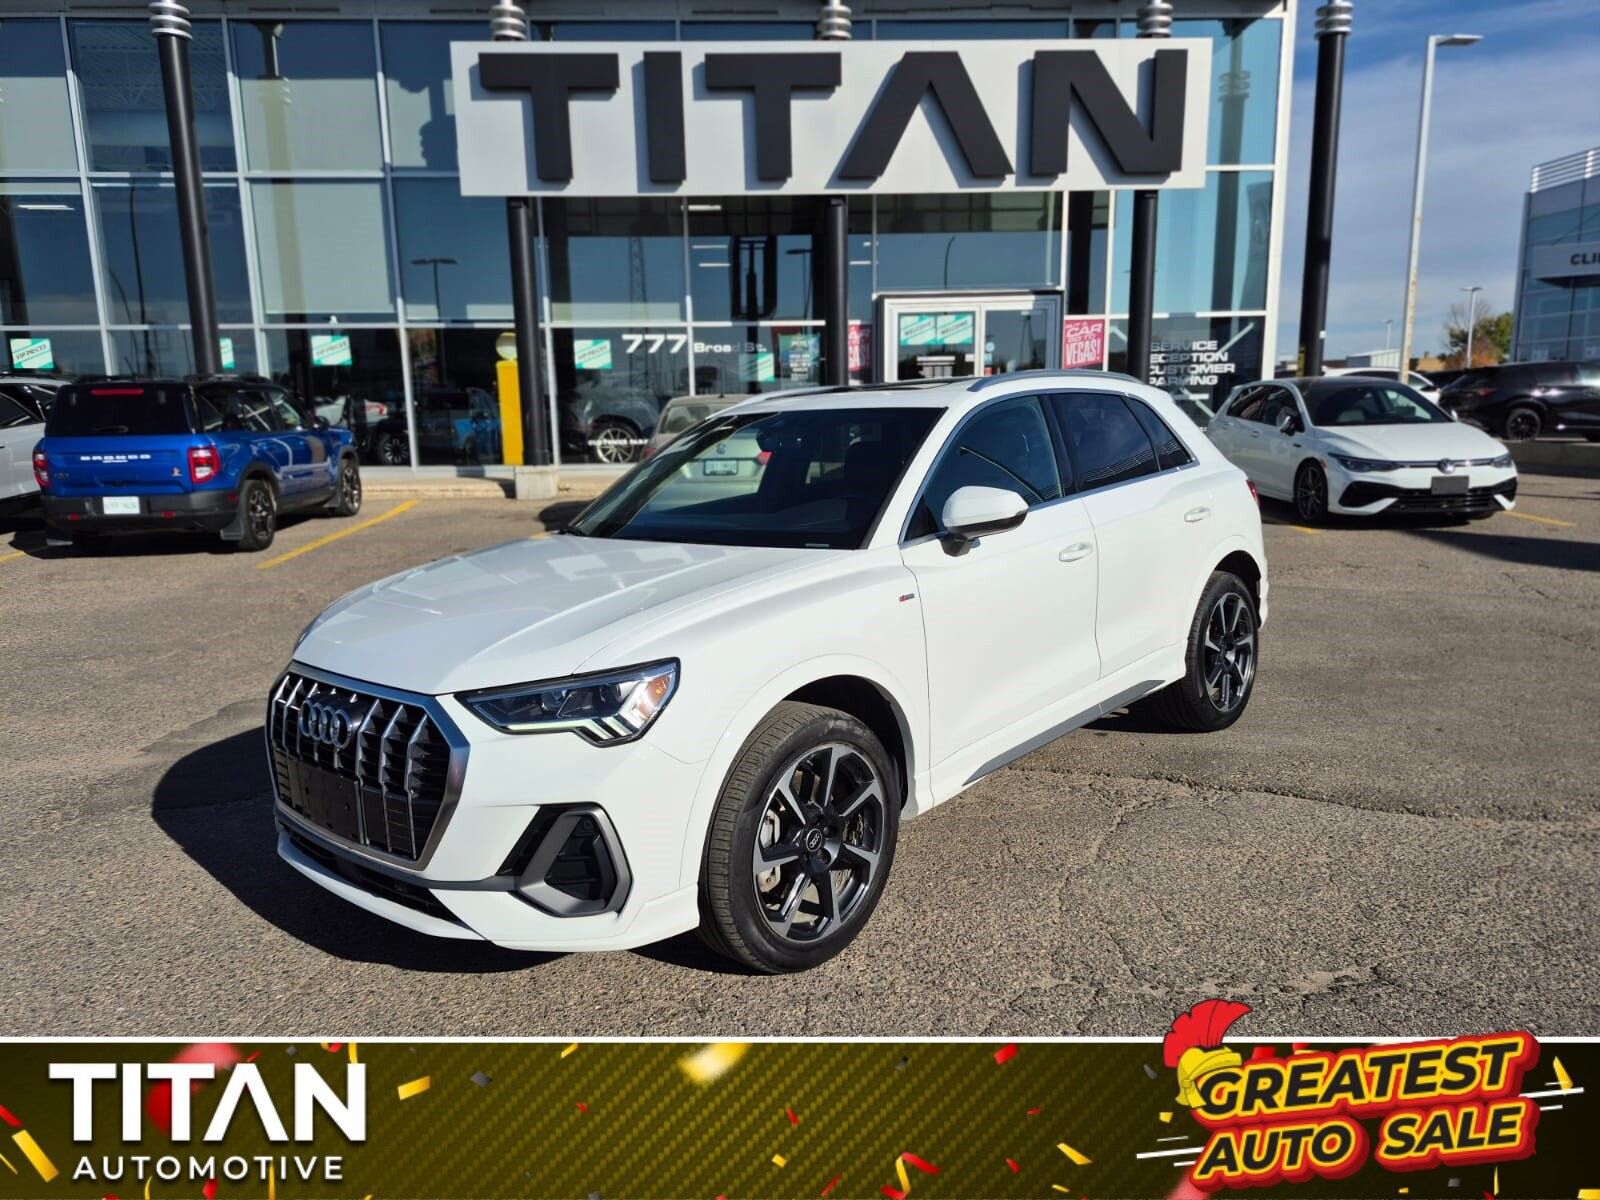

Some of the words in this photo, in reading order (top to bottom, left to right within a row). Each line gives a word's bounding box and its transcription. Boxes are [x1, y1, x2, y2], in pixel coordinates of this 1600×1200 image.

[477, 49, 1189, 184] TITAN
[1570, 252, 1600, 266] CLI
[1066, 323, 1103, 338] CAR
[621, 333, 688, 354] 777
[694, 342, 739, 353] Broad
[1150, 340, 1218, 352] SERVICE
[1066, 338, 1100, 365] VEGAS!
[1149, 352, 1229, 364] ECEPTION
[1149, 363, 1236, 376] CUSTOMER
